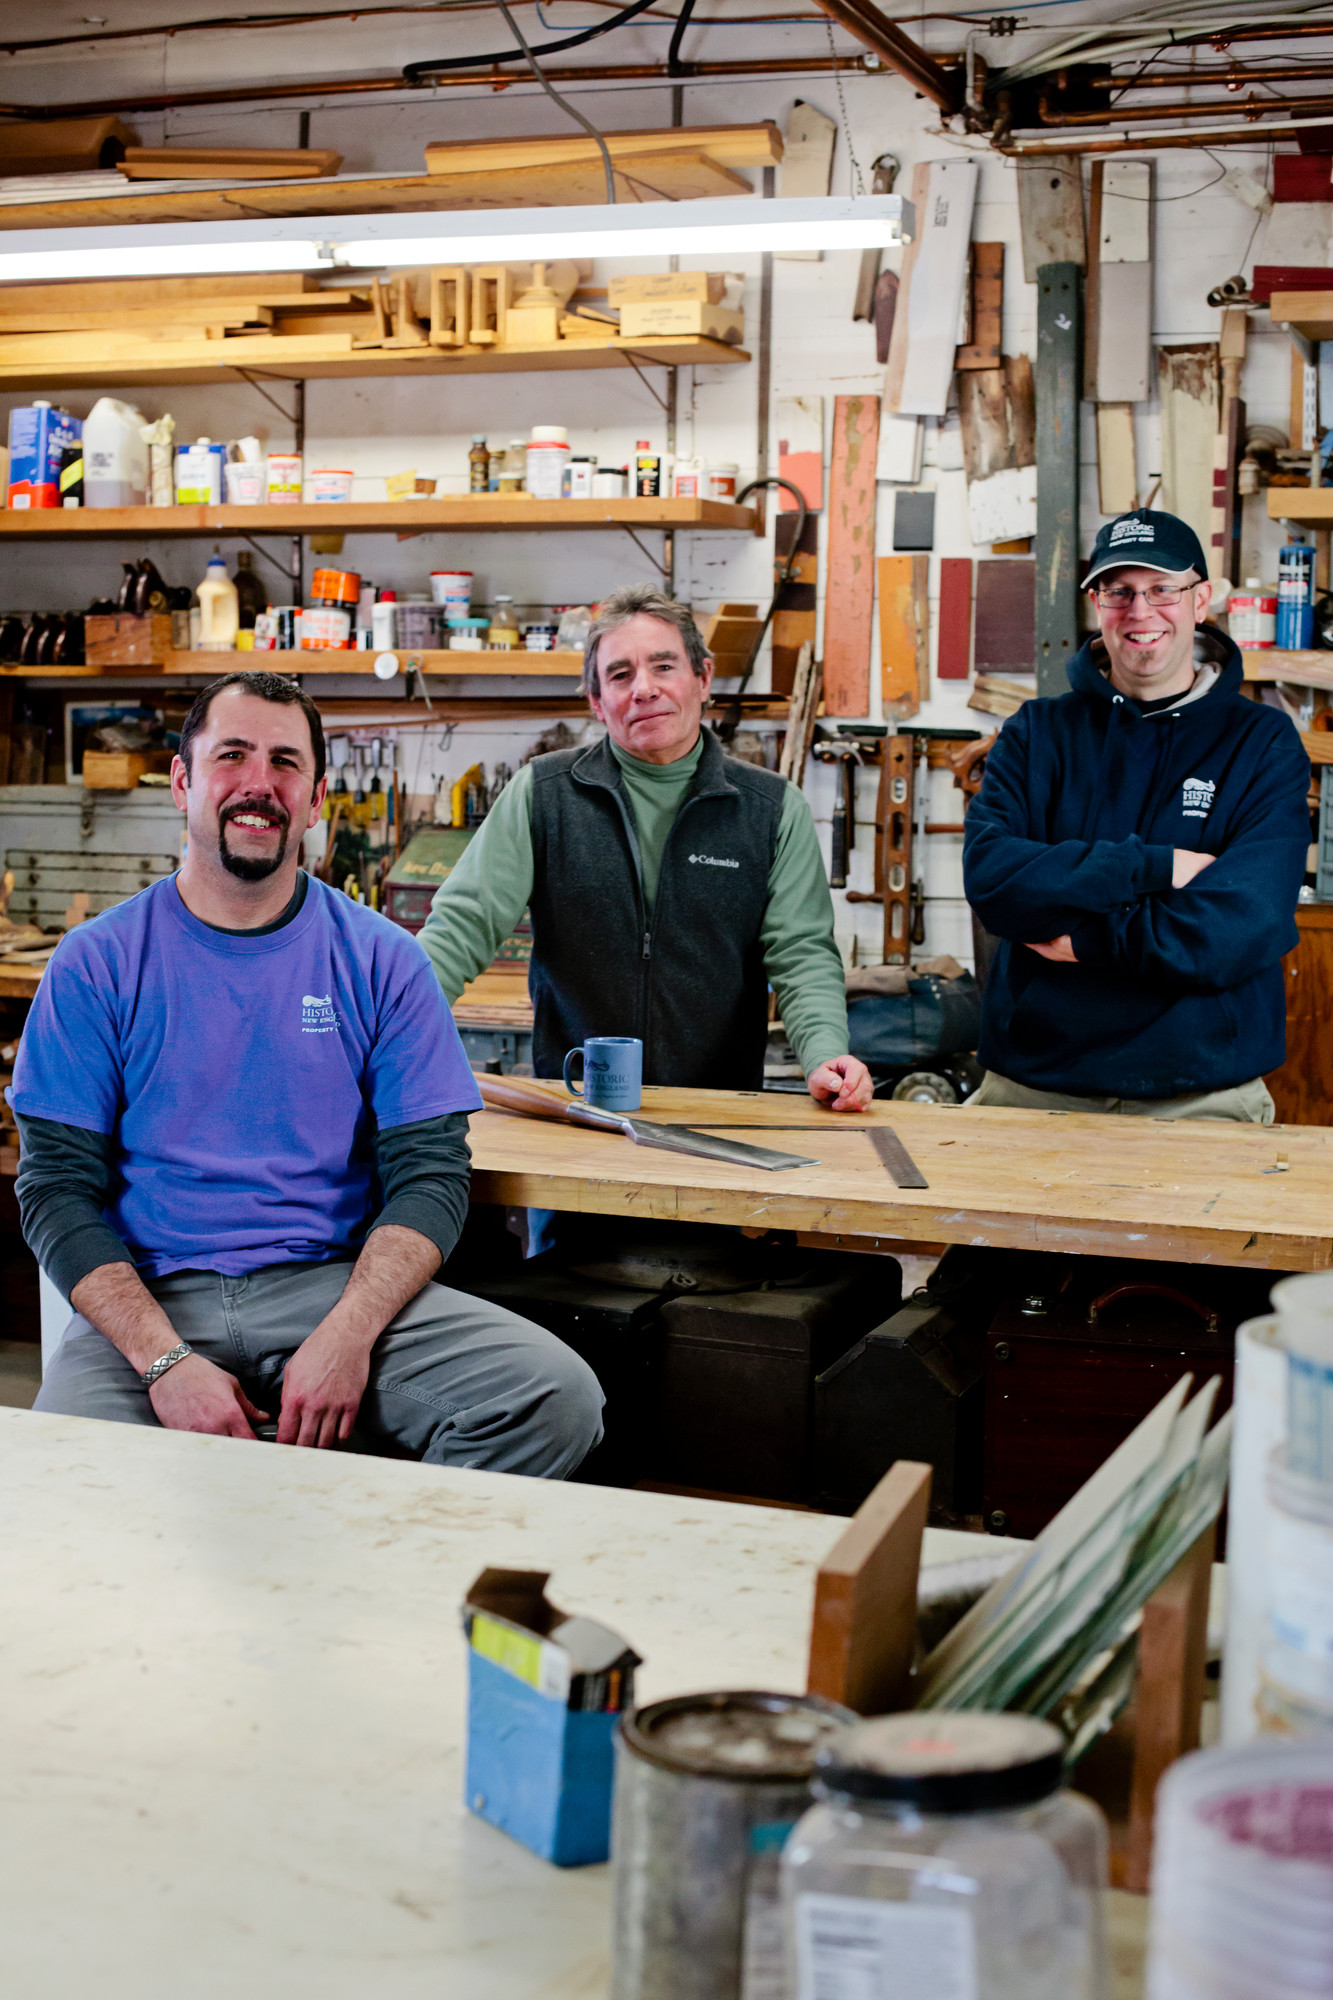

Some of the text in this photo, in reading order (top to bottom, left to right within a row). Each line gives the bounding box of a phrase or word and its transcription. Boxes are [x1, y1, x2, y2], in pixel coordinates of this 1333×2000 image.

[1183, 791, 1215, 803] HISTO
[698, 854, 740, 869] Columbia
[302, 1007, 342, 1021] HISTOC
